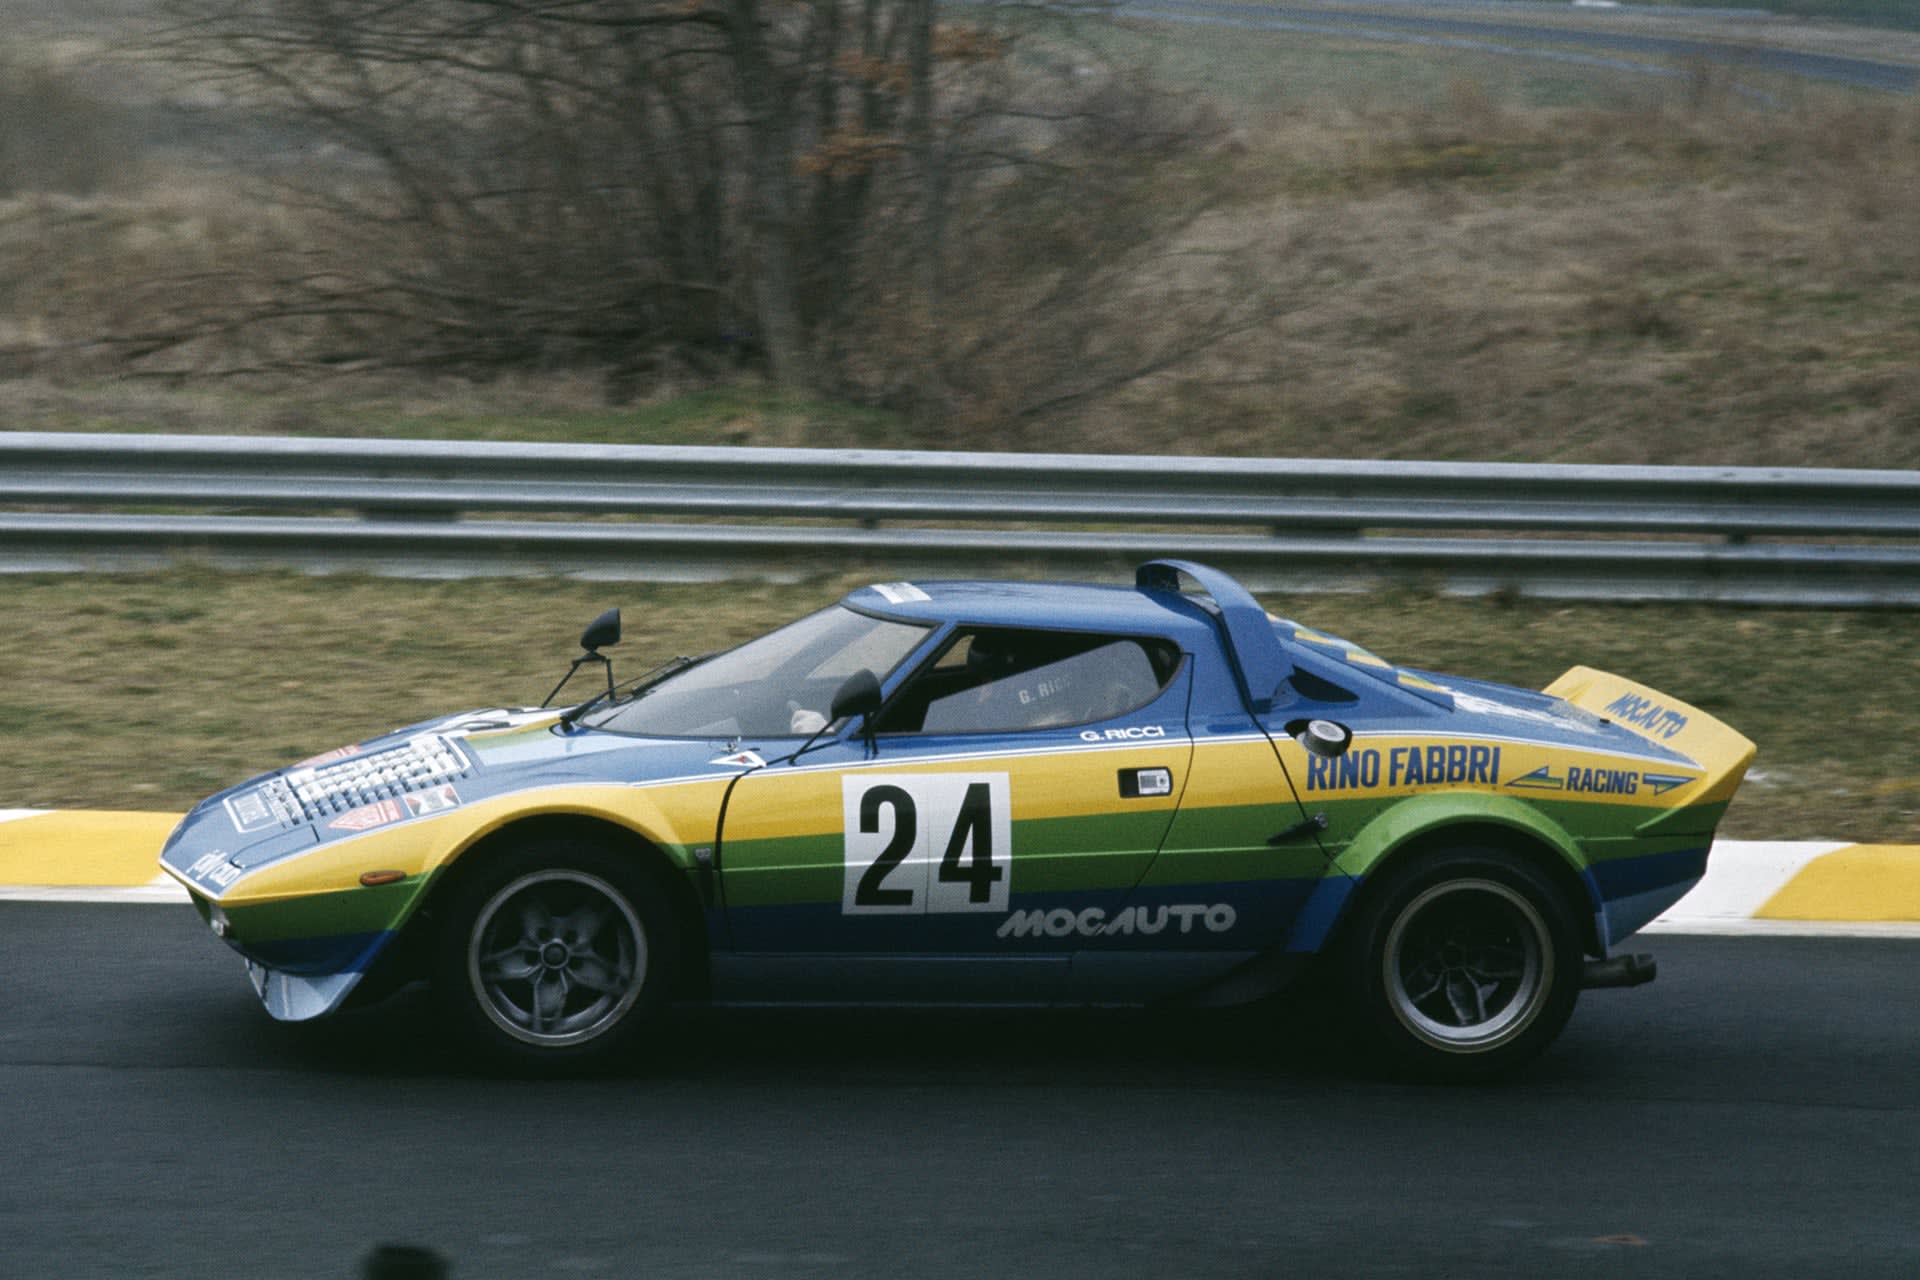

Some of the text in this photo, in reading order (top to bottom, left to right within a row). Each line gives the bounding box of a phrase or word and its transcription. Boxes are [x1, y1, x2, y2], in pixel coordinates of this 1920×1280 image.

[1603, 691, 1689, 739] MOCAUTO
[1306, 744, 1502, 791] RINO FABBRI
[1566, 766, 1639, 795] RACING
[854, 782, 1003, 907] 24
[996, 903, 1237, 939] MOCAUTO
